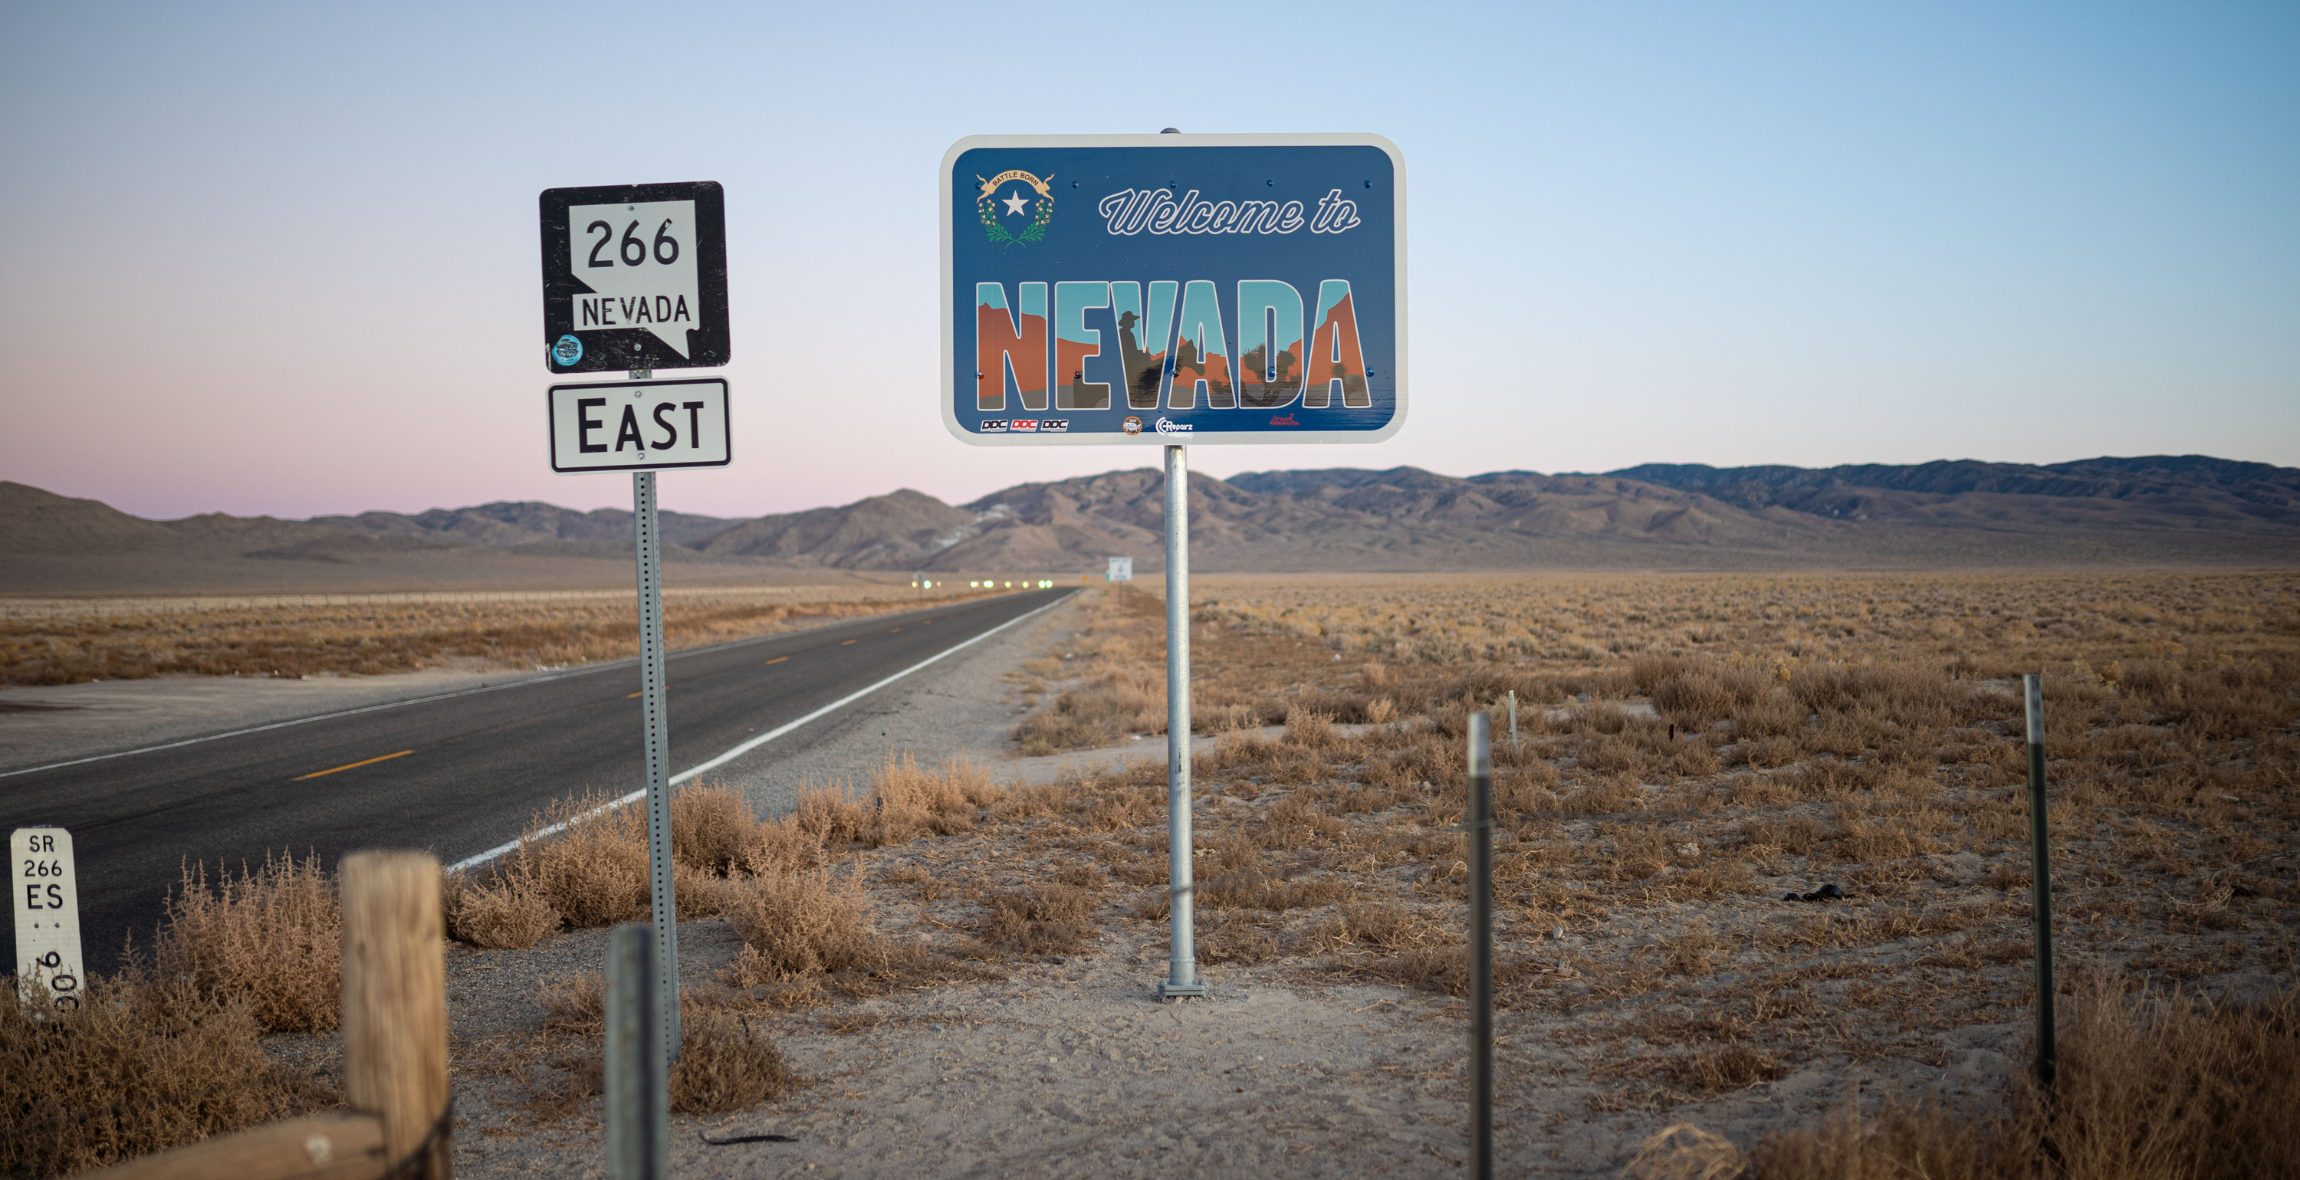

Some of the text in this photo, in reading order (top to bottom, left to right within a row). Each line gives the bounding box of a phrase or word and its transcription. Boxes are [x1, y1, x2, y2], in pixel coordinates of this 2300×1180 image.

[992, 171, 1039, 187] BATTLE BORN
[1098, 188, 1361, 235] Welcome to
[586, 217, 680, 269] 266
[582, 294, 691, 326] NEVADA
[976, 280, 1372, 410] NEVADA
[577, 397, 705, 454] EAST
[981, 420, 1008, 430] DDC
[1011, 419, 1038, 429] DDC
[1042, 420, 1068, 429] DDC
[29, 835, 55, 853] SR
[24, 859, 63, 877] 266
[27, 883, 64, 910] ES
